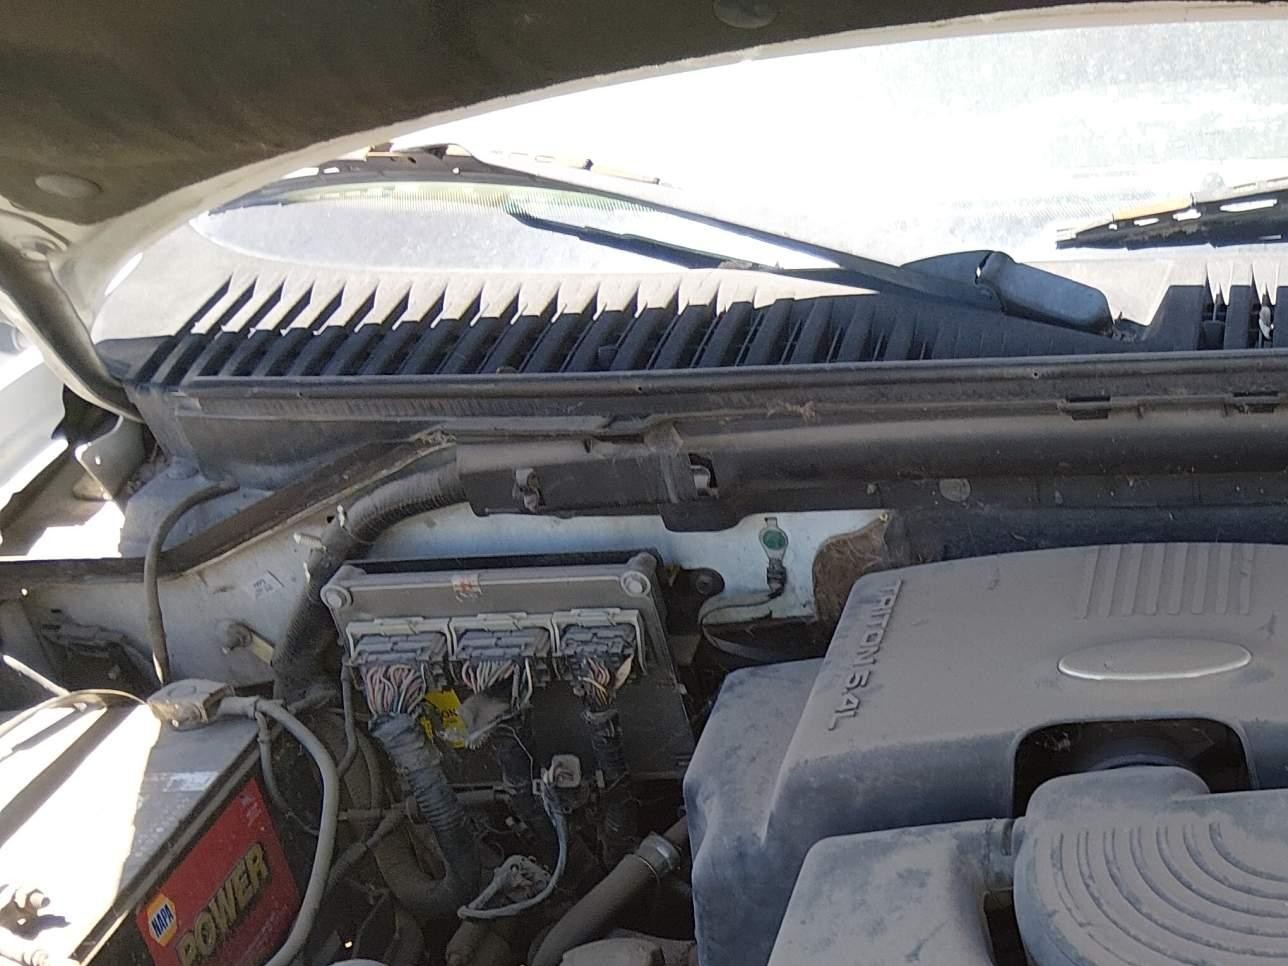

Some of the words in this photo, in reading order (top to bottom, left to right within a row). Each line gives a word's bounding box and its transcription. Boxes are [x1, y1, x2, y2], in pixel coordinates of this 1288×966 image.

[853, 579, 902, 667] TRITON
[827, 670, 871, 731] 5.4L
[151, 904, 174, 938] NAPA
